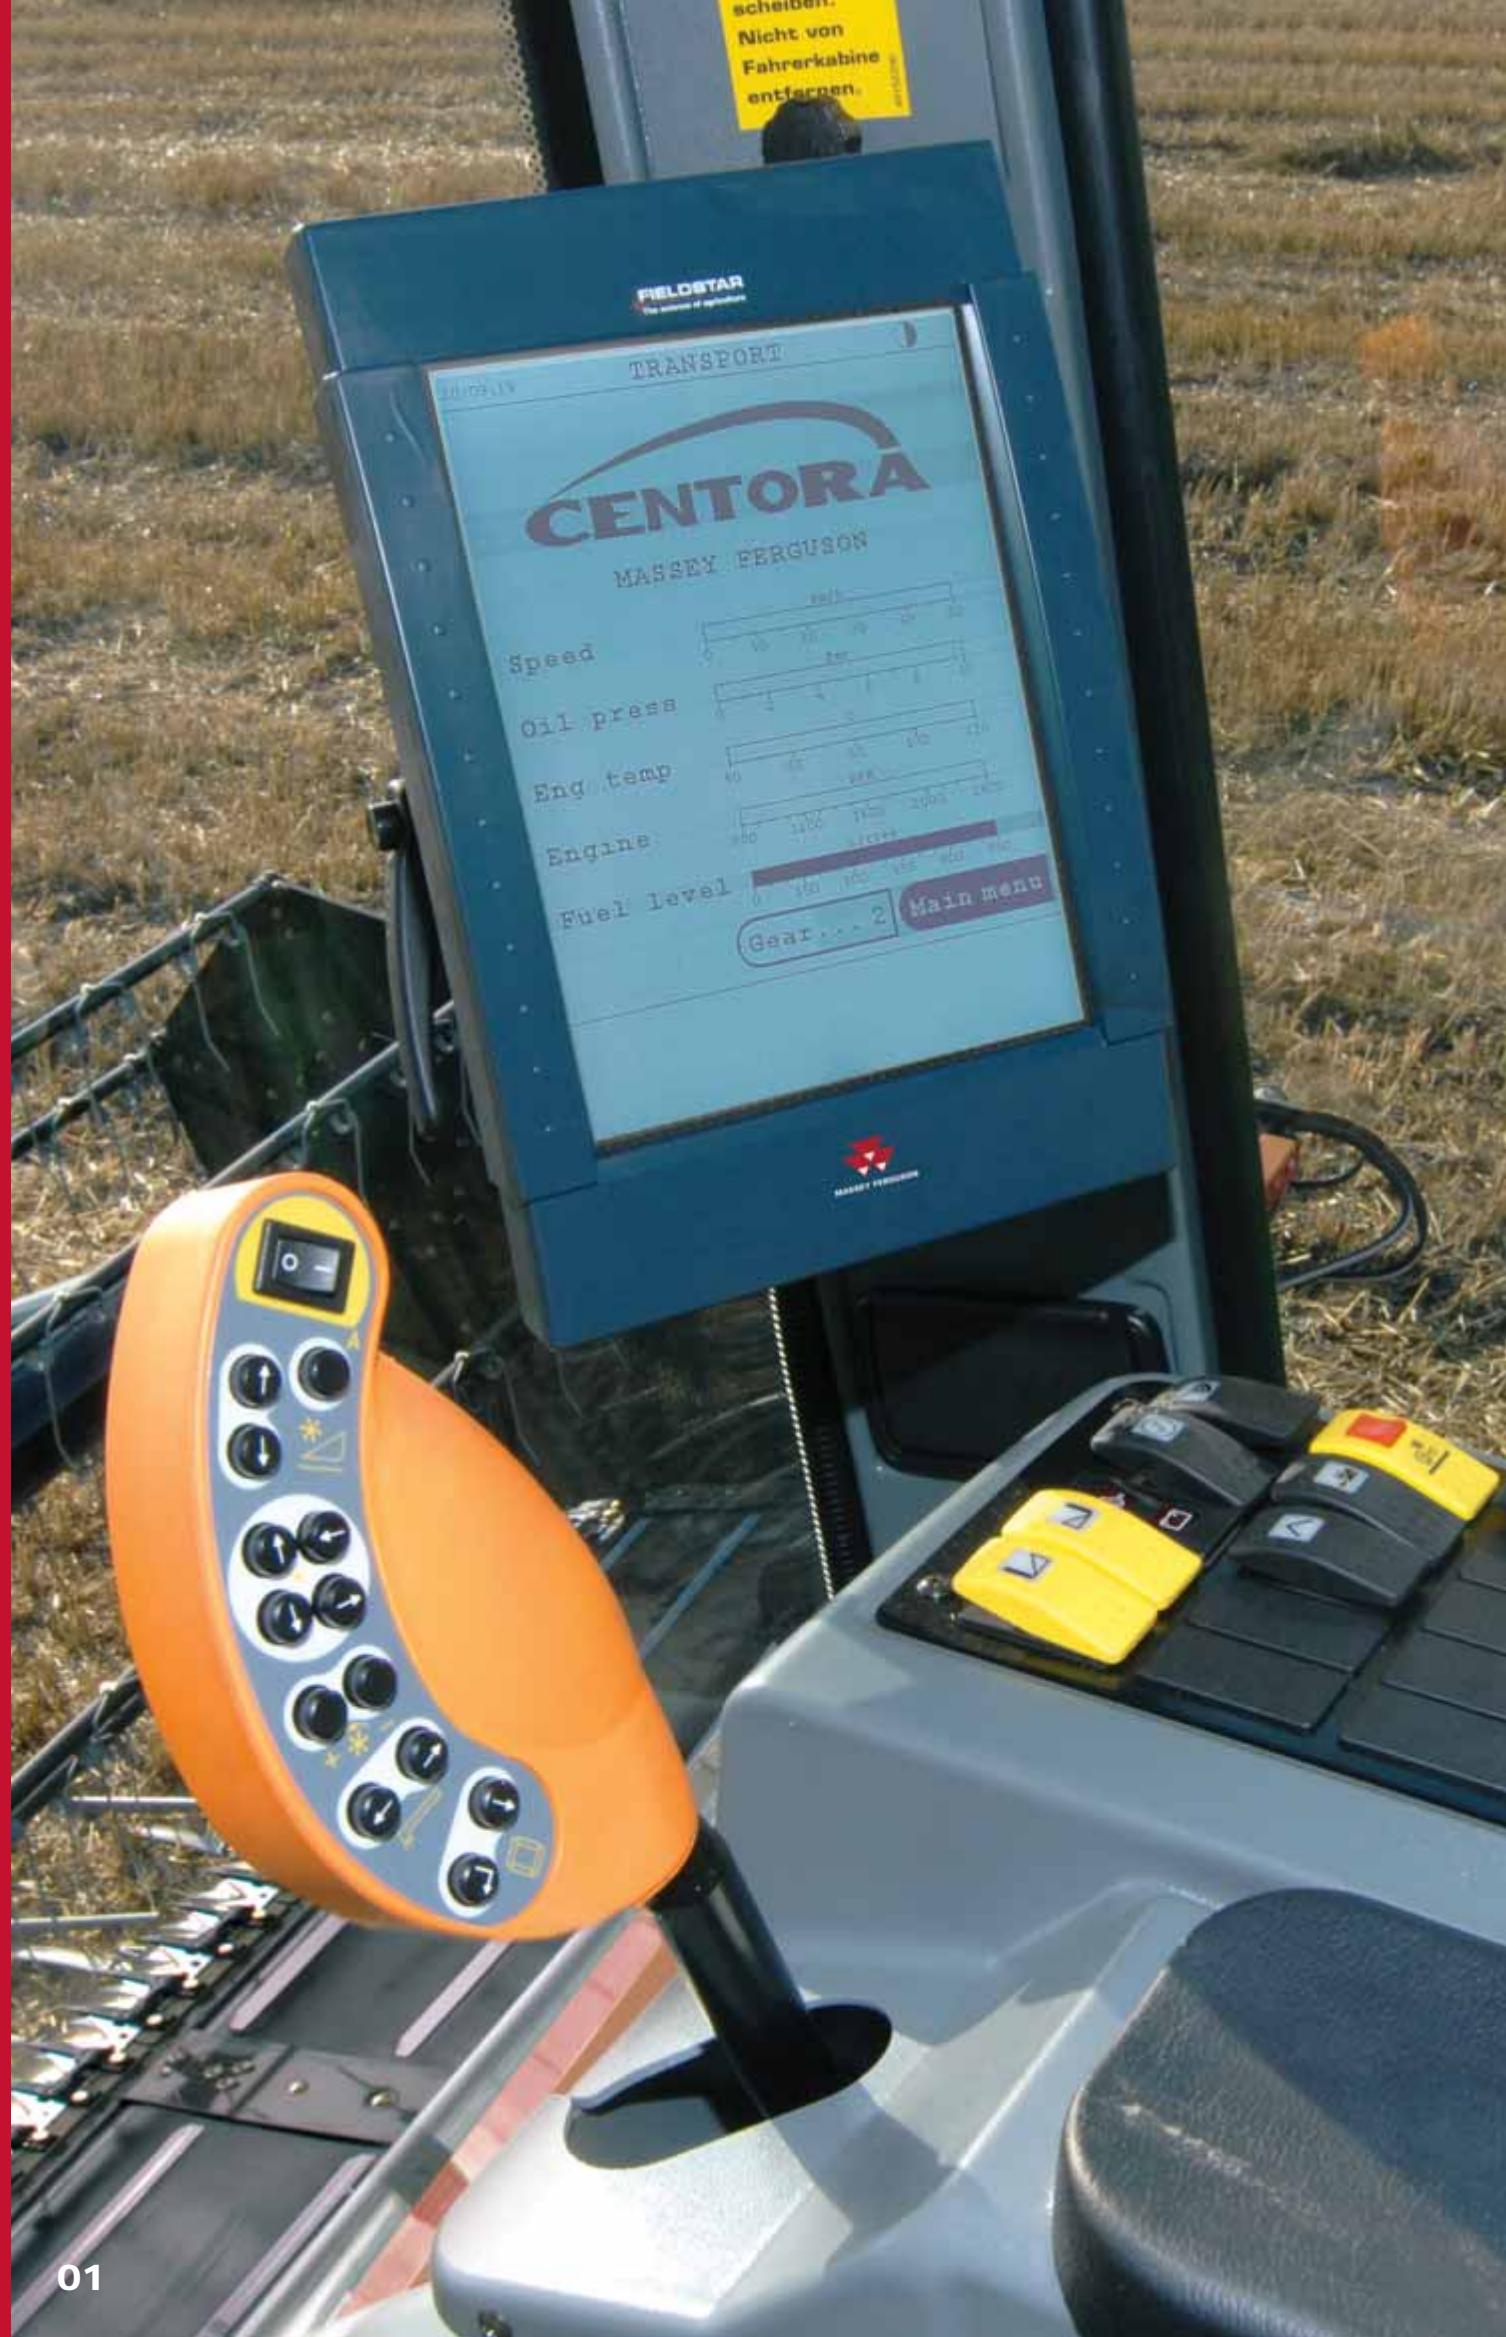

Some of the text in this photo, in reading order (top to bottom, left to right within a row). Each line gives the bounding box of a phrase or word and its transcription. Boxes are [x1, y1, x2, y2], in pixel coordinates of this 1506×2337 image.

[738, 24, 844, 45] Nicht von
[742, 50, 880, 75] Fahrerkabine
[636, 274, 744, 303] FIELDSTAR
[629, 344, 783, 380] TRANSPORT
[525, 452, 930, 547] CENTORA
[613, 530, 869, 588] MASSEY FERGUSON
[509, 643, 595, 676] Speed
[521, 698, 677, 738] Oil press
[534, 764, 672, 803] Eng temp
[547, 833, 650, 866] Engine
[561, 876, 731, 929] Fuel level
[872, 906, 887, 925] 2
[908, 876, 1044, 919] Main menu
